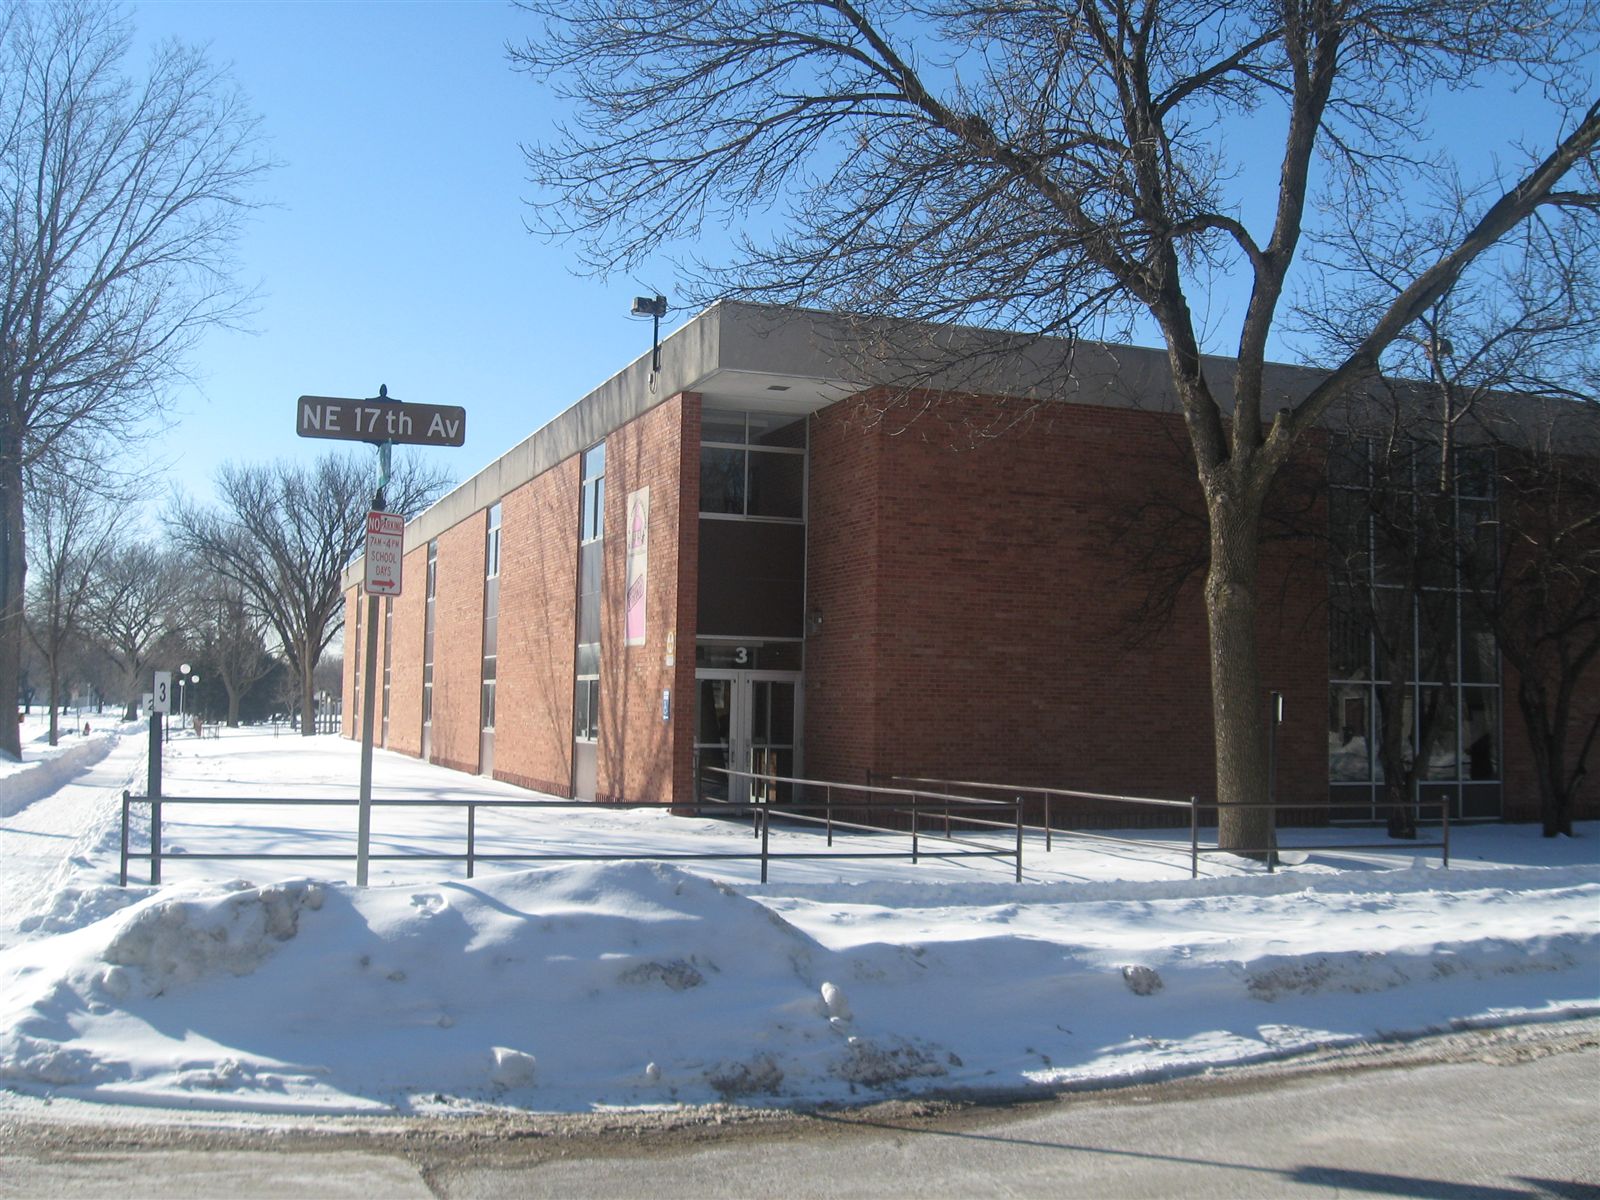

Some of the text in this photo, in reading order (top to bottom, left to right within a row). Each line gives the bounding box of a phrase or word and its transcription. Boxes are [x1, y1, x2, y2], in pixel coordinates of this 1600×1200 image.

[303, 404, 460, 438] NE 17th Av
[368, 517, 380, 531] NO
[371, 550, 396, 564] SCHOOL
[375, 565, 392, 577] DAYS
[735, 647, 748, 663] 3
[159, 682, 166, 702] 3
[148, 699, 154, 711] 2
